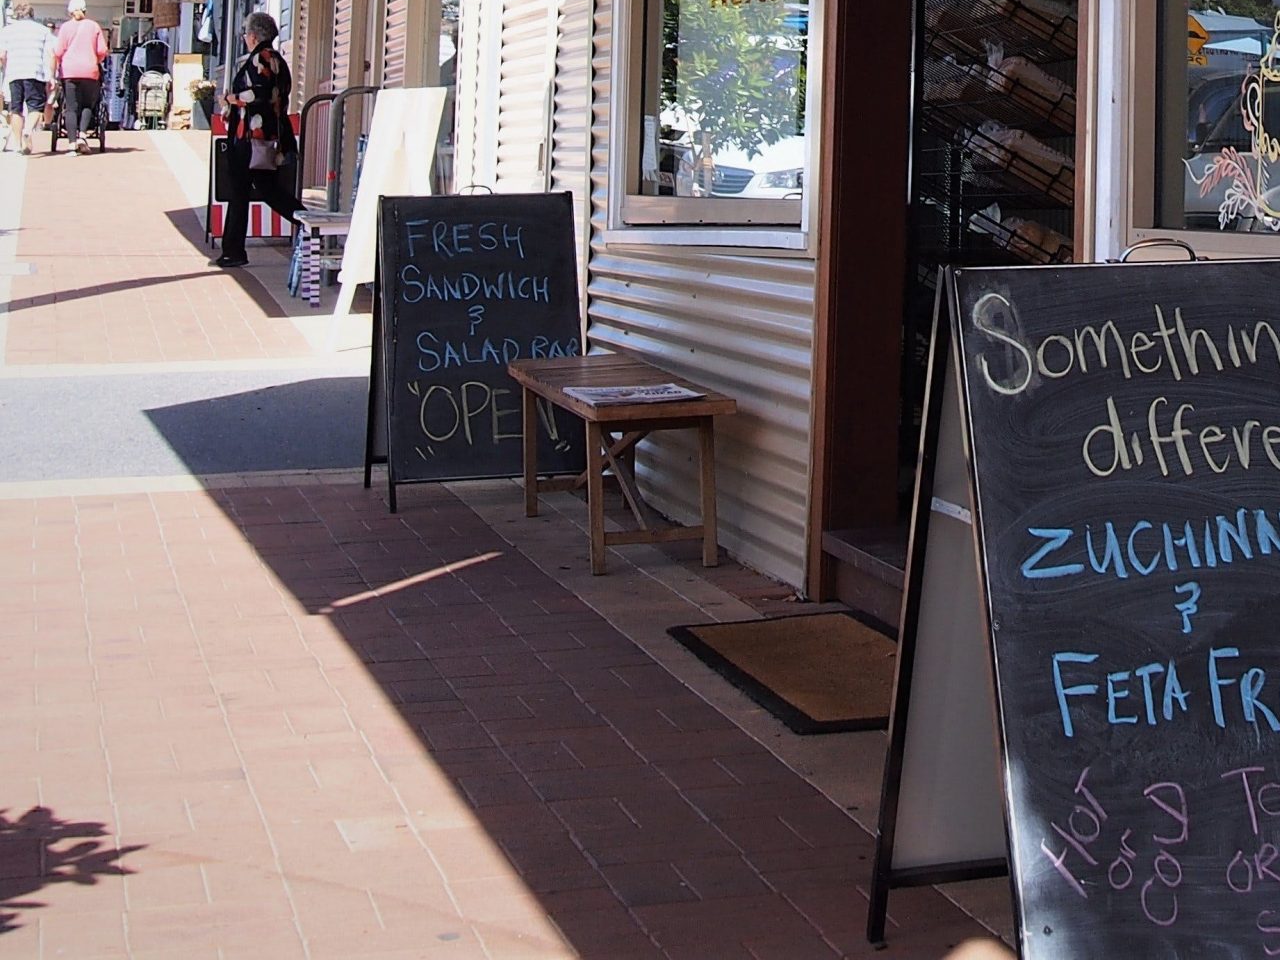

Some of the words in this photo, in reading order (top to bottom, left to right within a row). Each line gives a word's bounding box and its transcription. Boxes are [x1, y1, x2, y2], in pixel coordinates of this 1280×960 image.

[405, 219, 525, 259] FRESH
[401, 264, 550, 303] SANDWICH
[416, 331, 520, 373] SALAD
[1052, 652, 1191, 737] FETA
[1041, 767, 1109, 898] HOT
